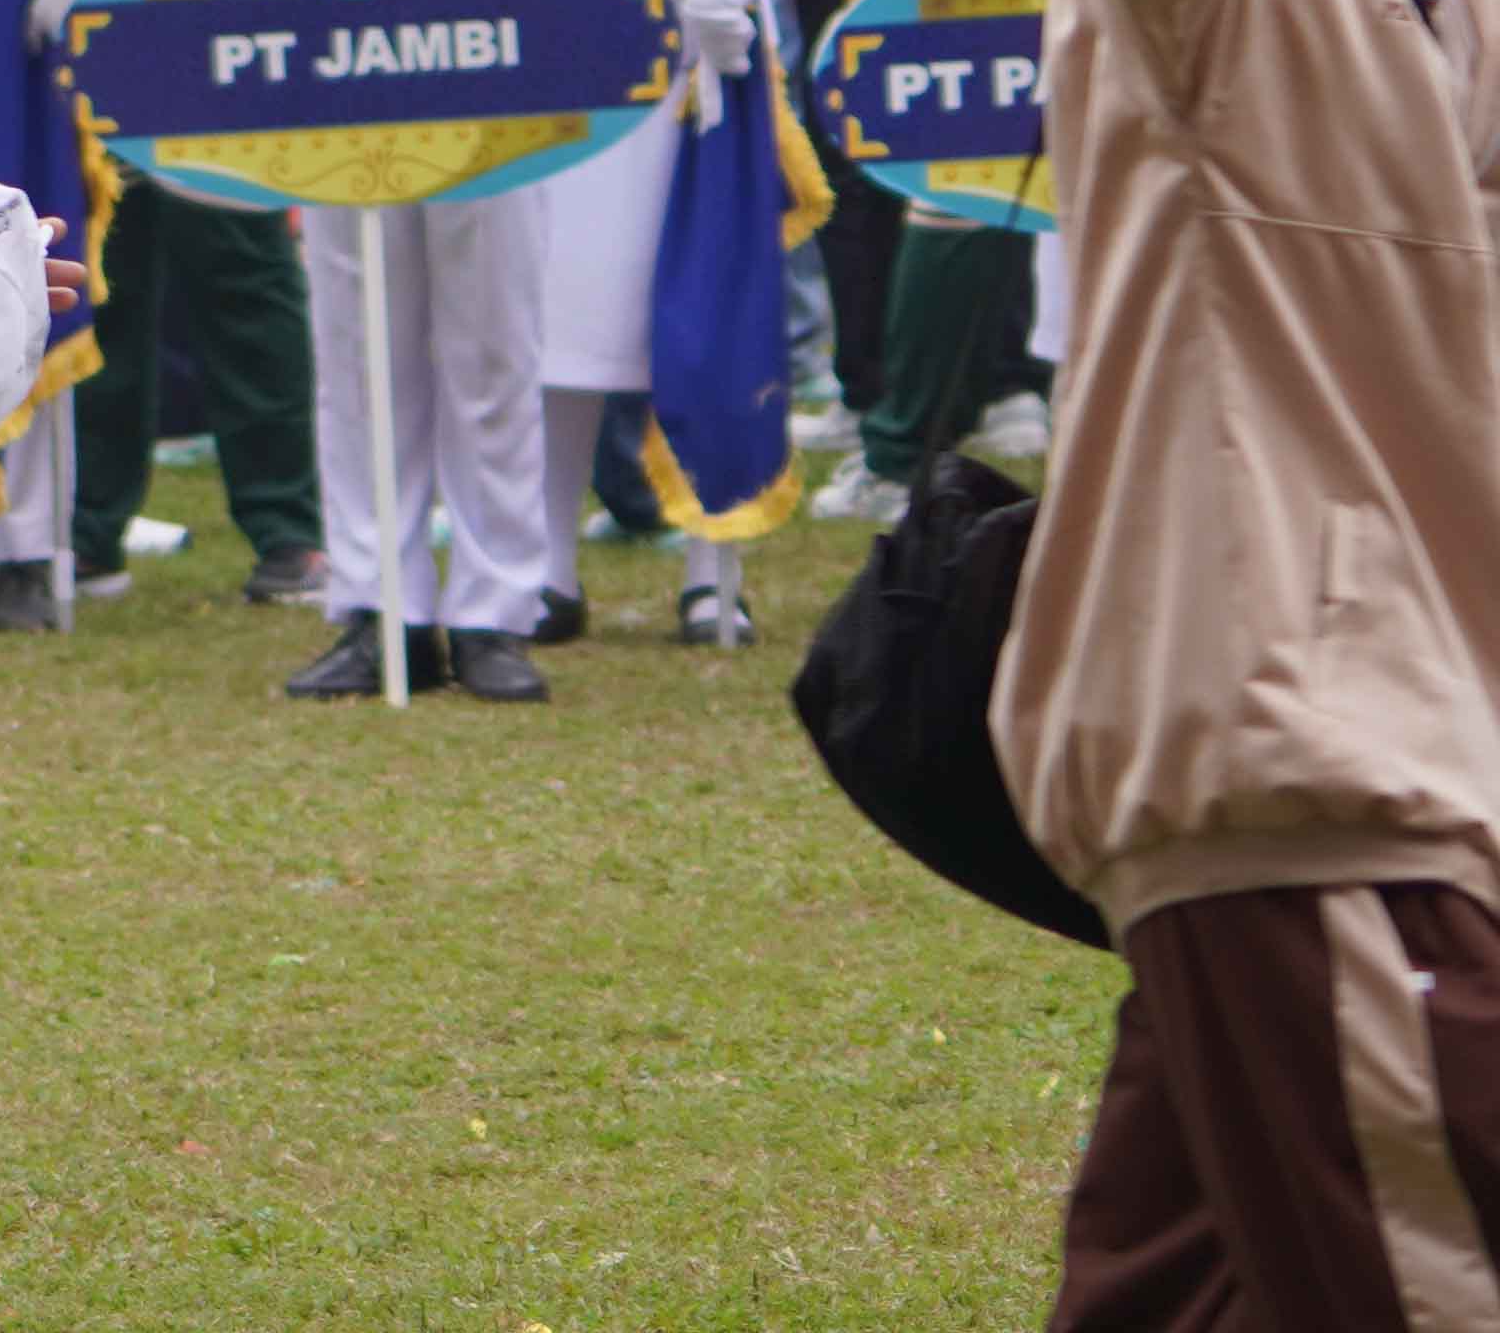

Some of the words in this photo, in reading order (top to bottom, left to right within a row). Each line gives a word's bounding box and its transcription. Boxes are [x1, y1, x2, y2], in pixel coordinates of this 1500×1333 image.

[211, 32, 297, 84] PT
[313, 17, 520, 79] JAMBI
[885, 59, 974, 114] PT
